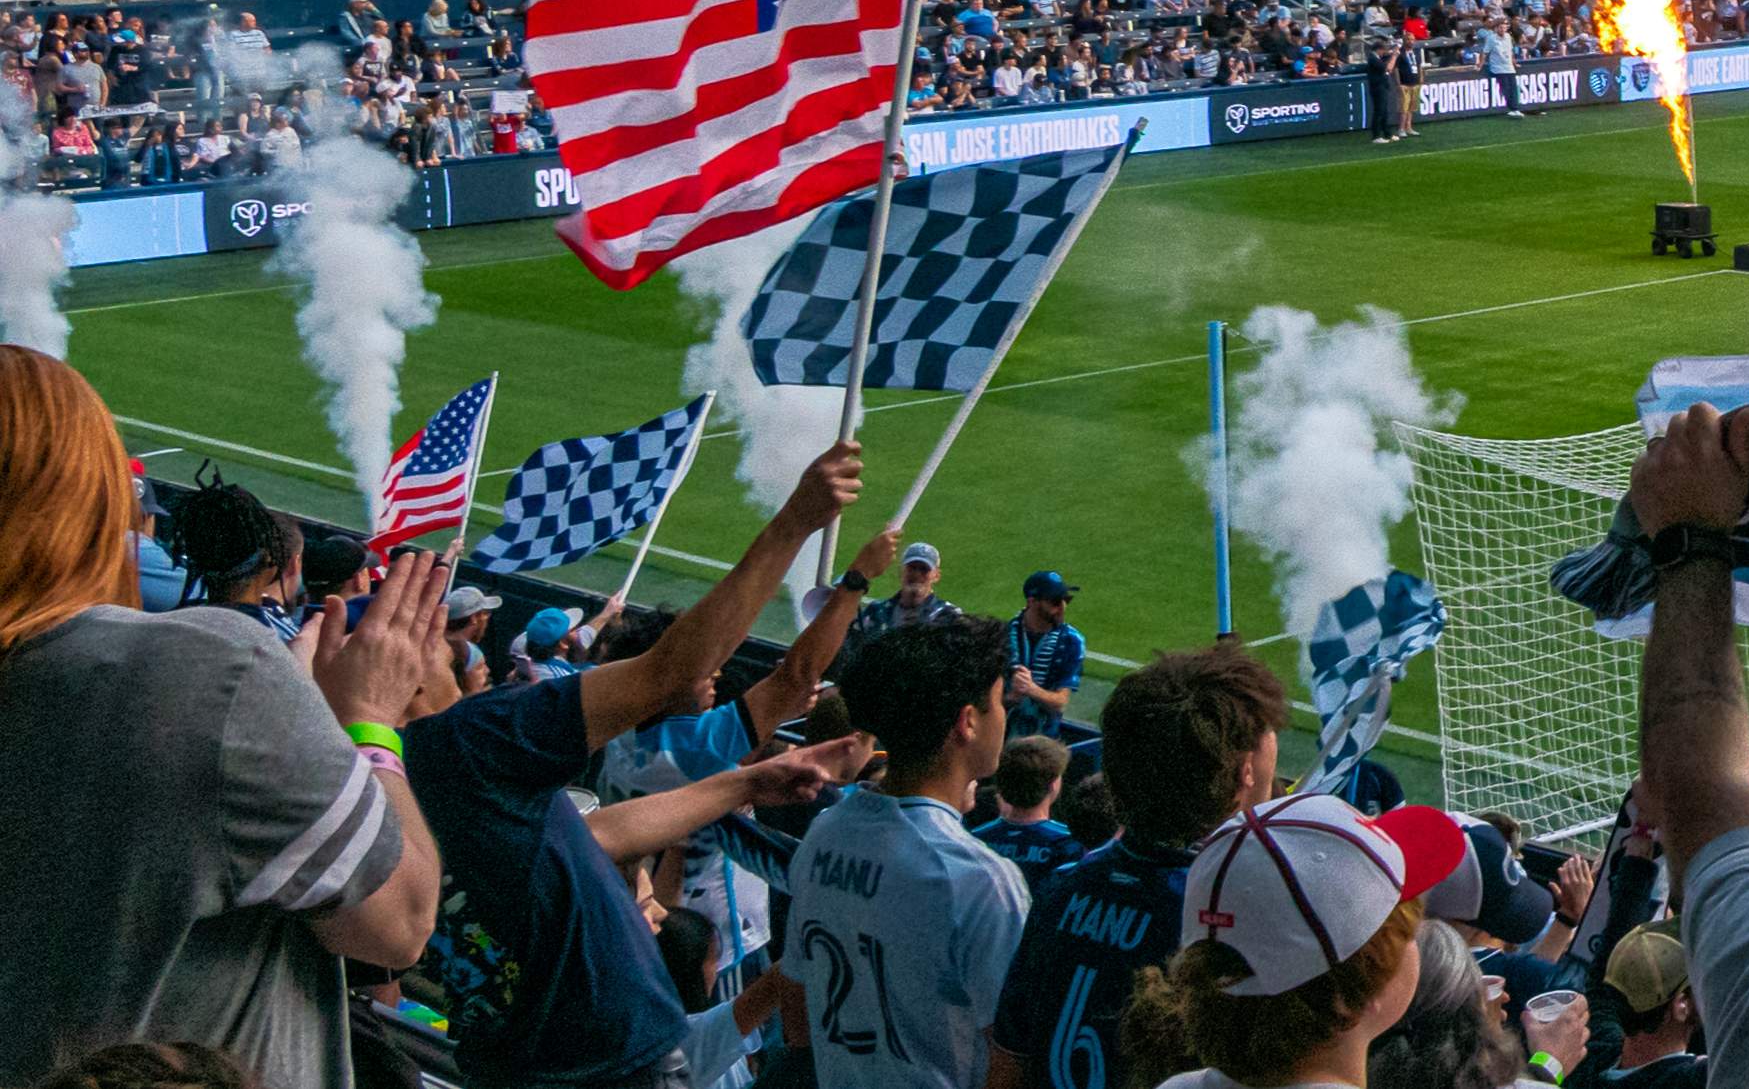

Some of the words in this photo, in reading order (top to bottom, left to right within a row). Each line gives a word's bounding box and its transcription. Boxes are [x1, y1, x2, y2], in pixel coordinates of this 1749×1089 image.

[1420, 79, 1489, 115] SPORTING
[1549, 69, 1579, 102] CITY
[1689, 57, 1720, 86] JOSE
[1251, 101, 1320, 120] SPORTING
[909, 129, 948, 168] SAN
[950, 124, 996, 164] JOSE
[1000, 114, 1119, 158] EARTHQUAKES
[808, 847, 884, 899] MANU
[1056, 892, 1152, 951] MANU
[801, 919, 914, 1065] 21
[1049, 964, 1107, 1089] 6
